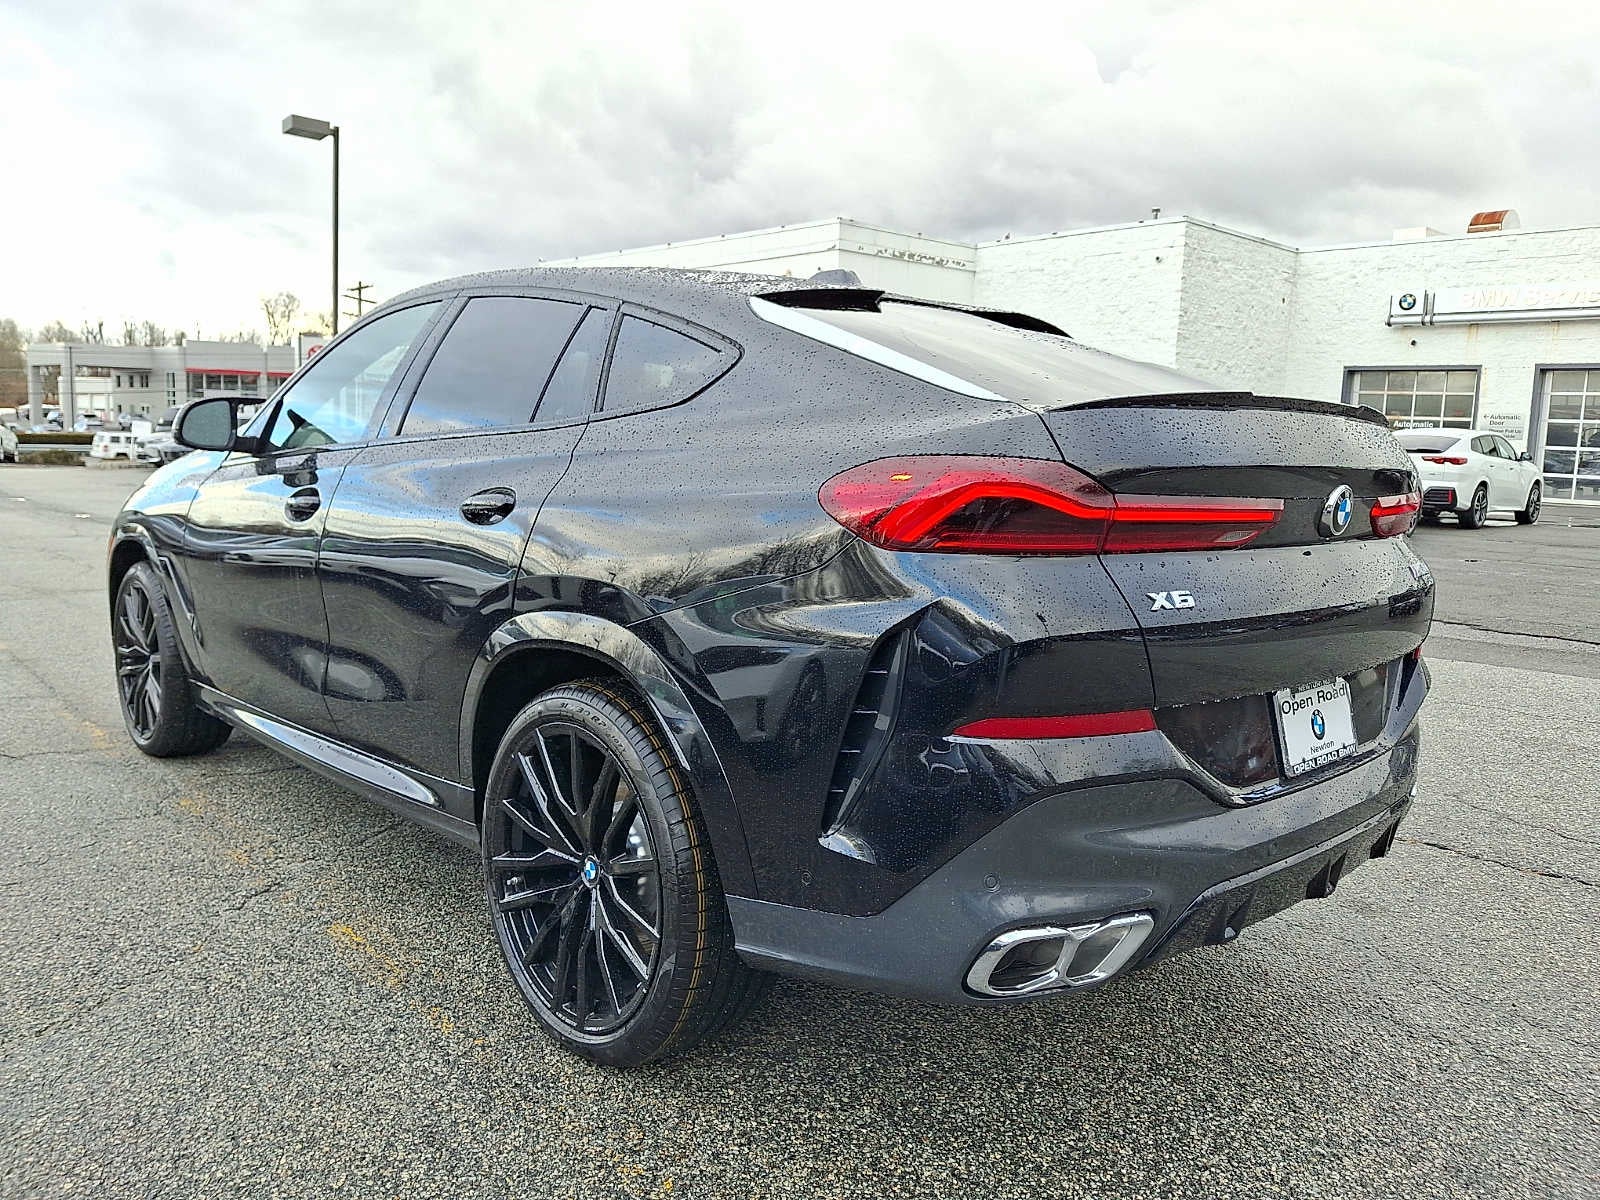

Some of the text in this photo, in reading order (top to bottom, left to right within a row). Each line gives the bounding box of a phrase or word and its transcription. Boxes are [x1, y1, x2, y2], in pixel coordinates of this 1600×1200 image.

[1463, 287, 1520, 308] BMW
[1393, 420, 1434, 428] Automatic
[1146, 590, 1196, 612] X6
[1281, 696, 1313, 715] Open
[1317, 685, 1345, 704] Road
[1310, 741, 1334, 754] Newton
[1293, 744, 1357, 774] OPEN ROAD BMW
